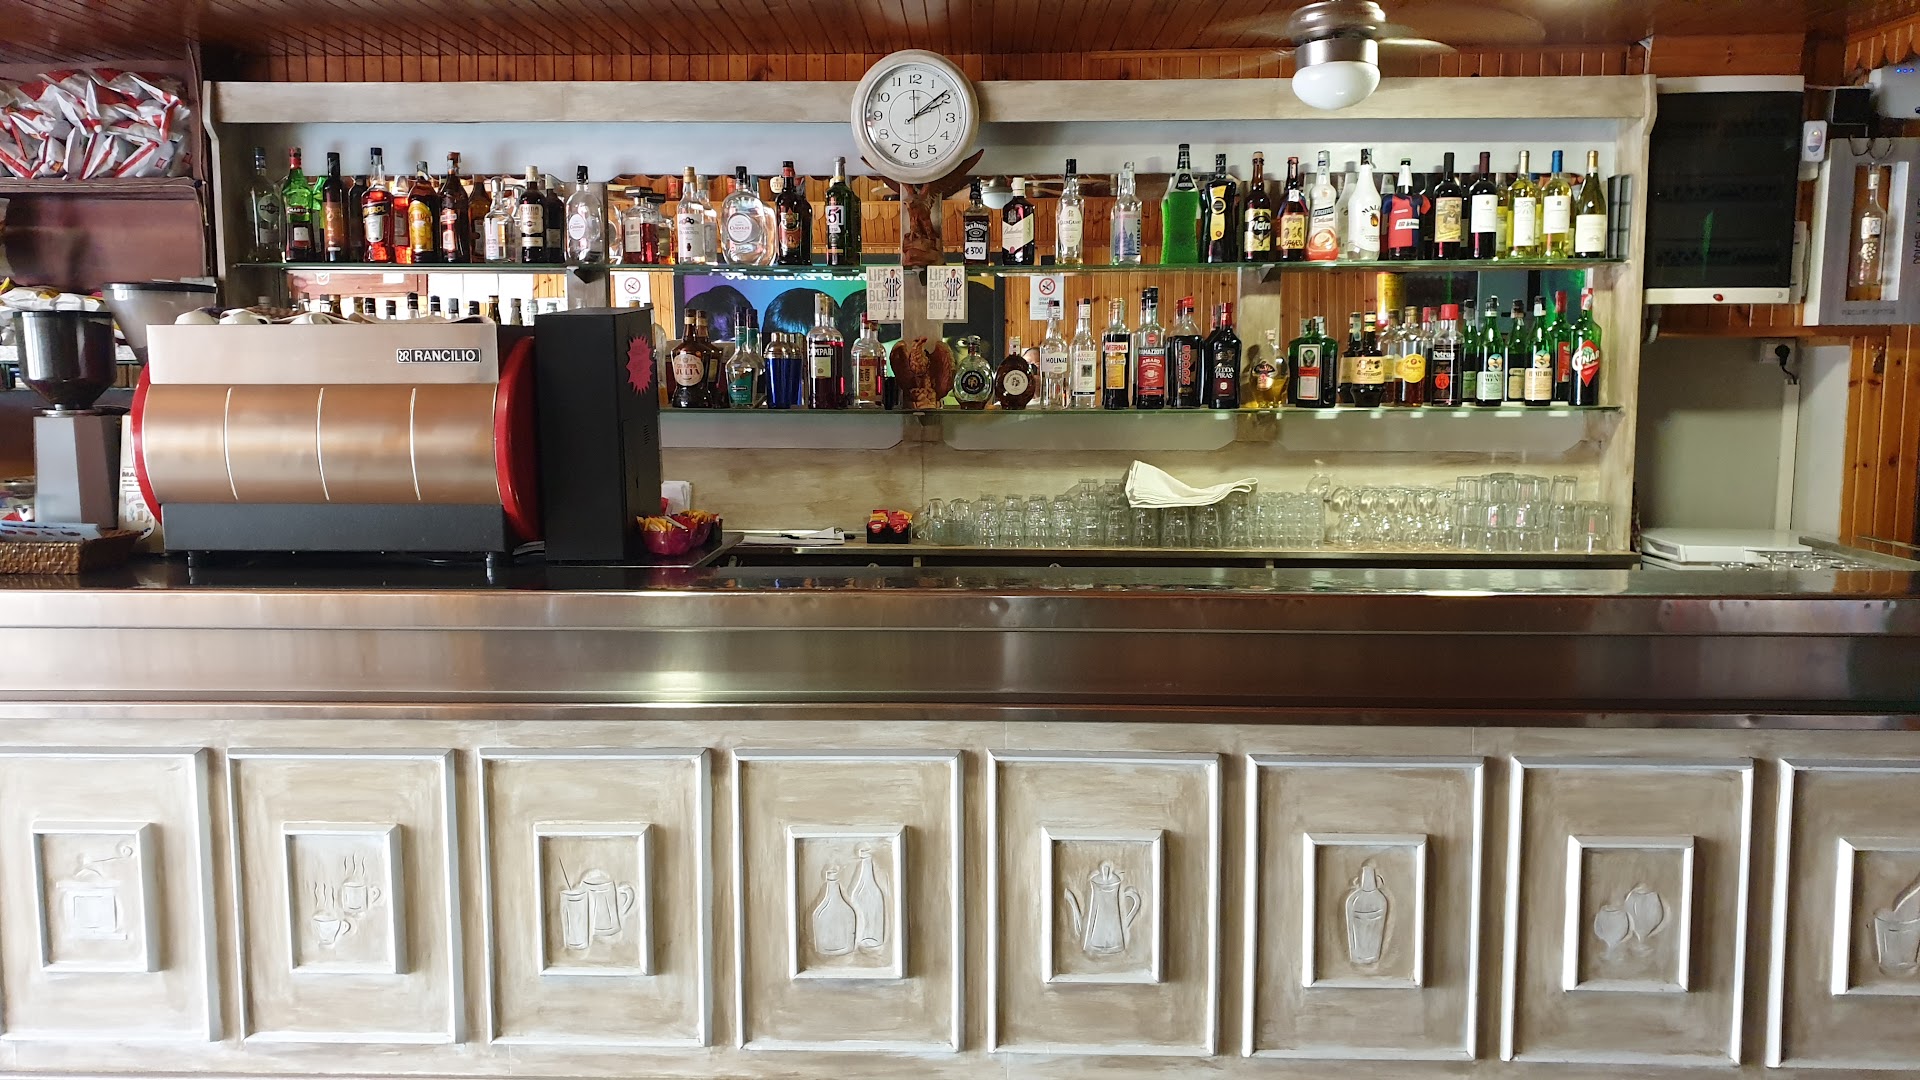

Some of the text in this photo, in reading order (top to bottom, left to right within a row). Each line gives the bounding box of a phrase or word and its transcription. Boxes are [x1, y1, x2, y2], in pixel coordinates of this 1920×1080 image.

[892, 77, 901, 87] 11
[909, 74, 922, 84] 12
[931, 79, 935, 89] 1
[877, 92, 890, 102] 10
[873, 110, 883, 121] 9
[945, 112, 956, 123] 3
[879, 128, 889, 140] 8
[940, 130, 949, 140] 4
[891, 143, 901, 153] 7
[909, 148, 919, 159] 6
[927, 144, 937, 155] 5
[827, 208, 842, 224] 51
[414, 350, 476, 361] RANCILIO
[1182, 345, 1191, 386] ZUCCA
[675, 368, 700, 376] JULIA
